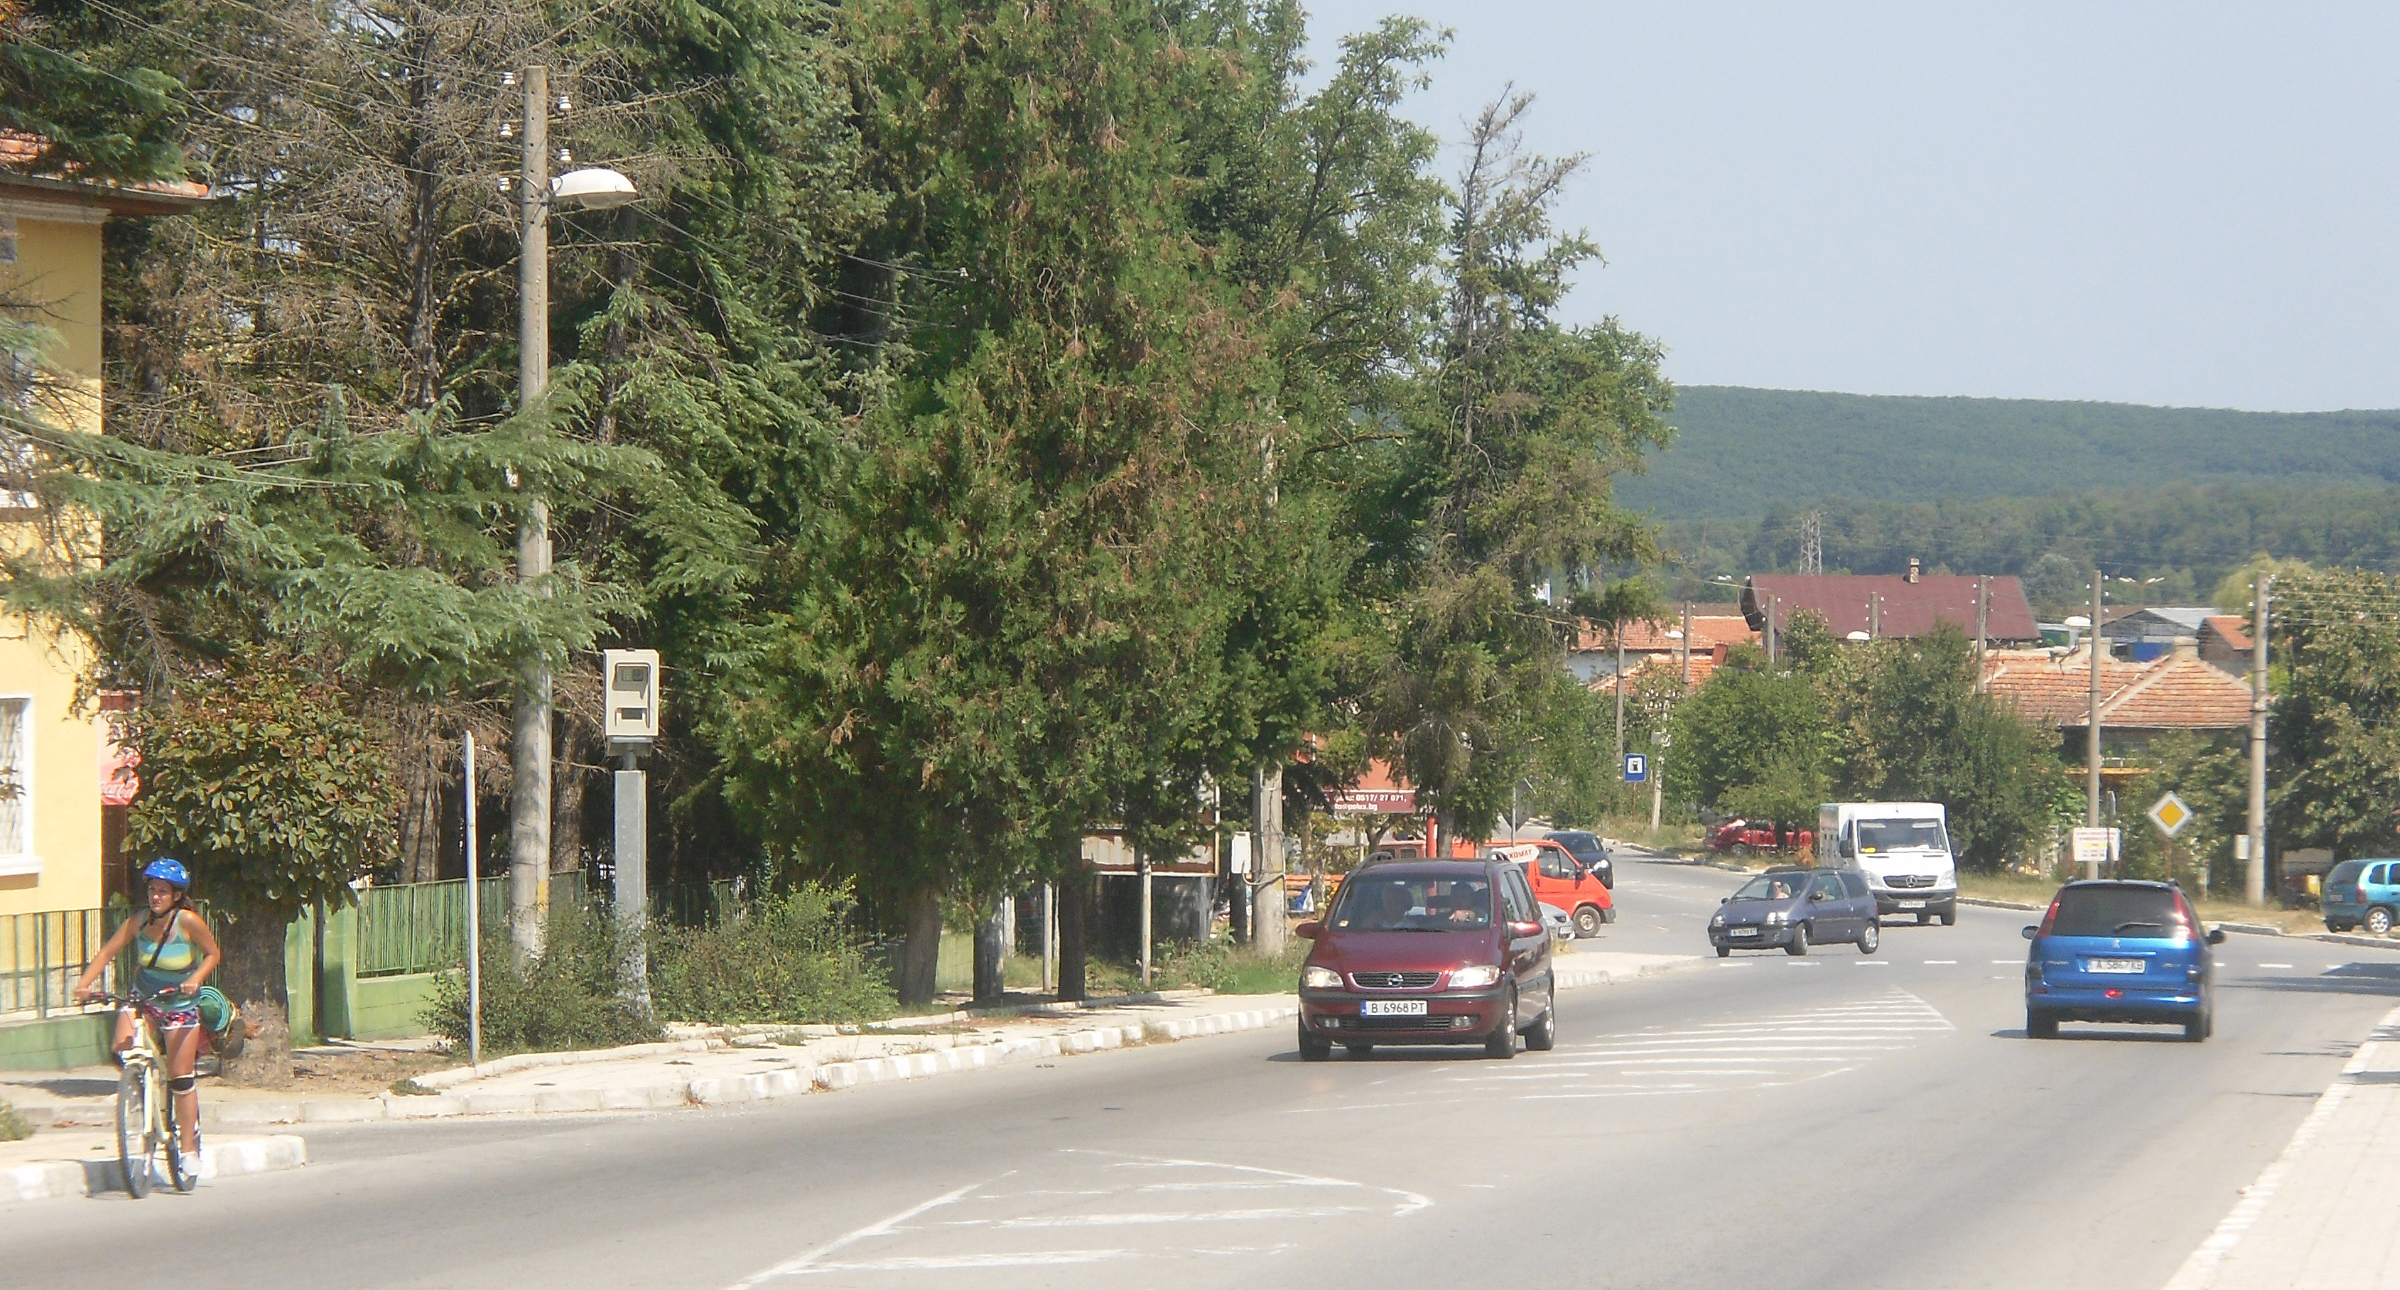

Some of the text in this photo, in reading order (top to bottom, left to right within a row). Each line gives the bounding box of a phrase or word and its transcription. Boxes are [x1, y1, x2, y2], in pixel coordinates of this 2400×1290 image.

[1356, 794, 1377, 802] 0517/
[1380, 794, 1388, 802] 27
[1371, 1003, 1424, 1013] B 6968 PT
